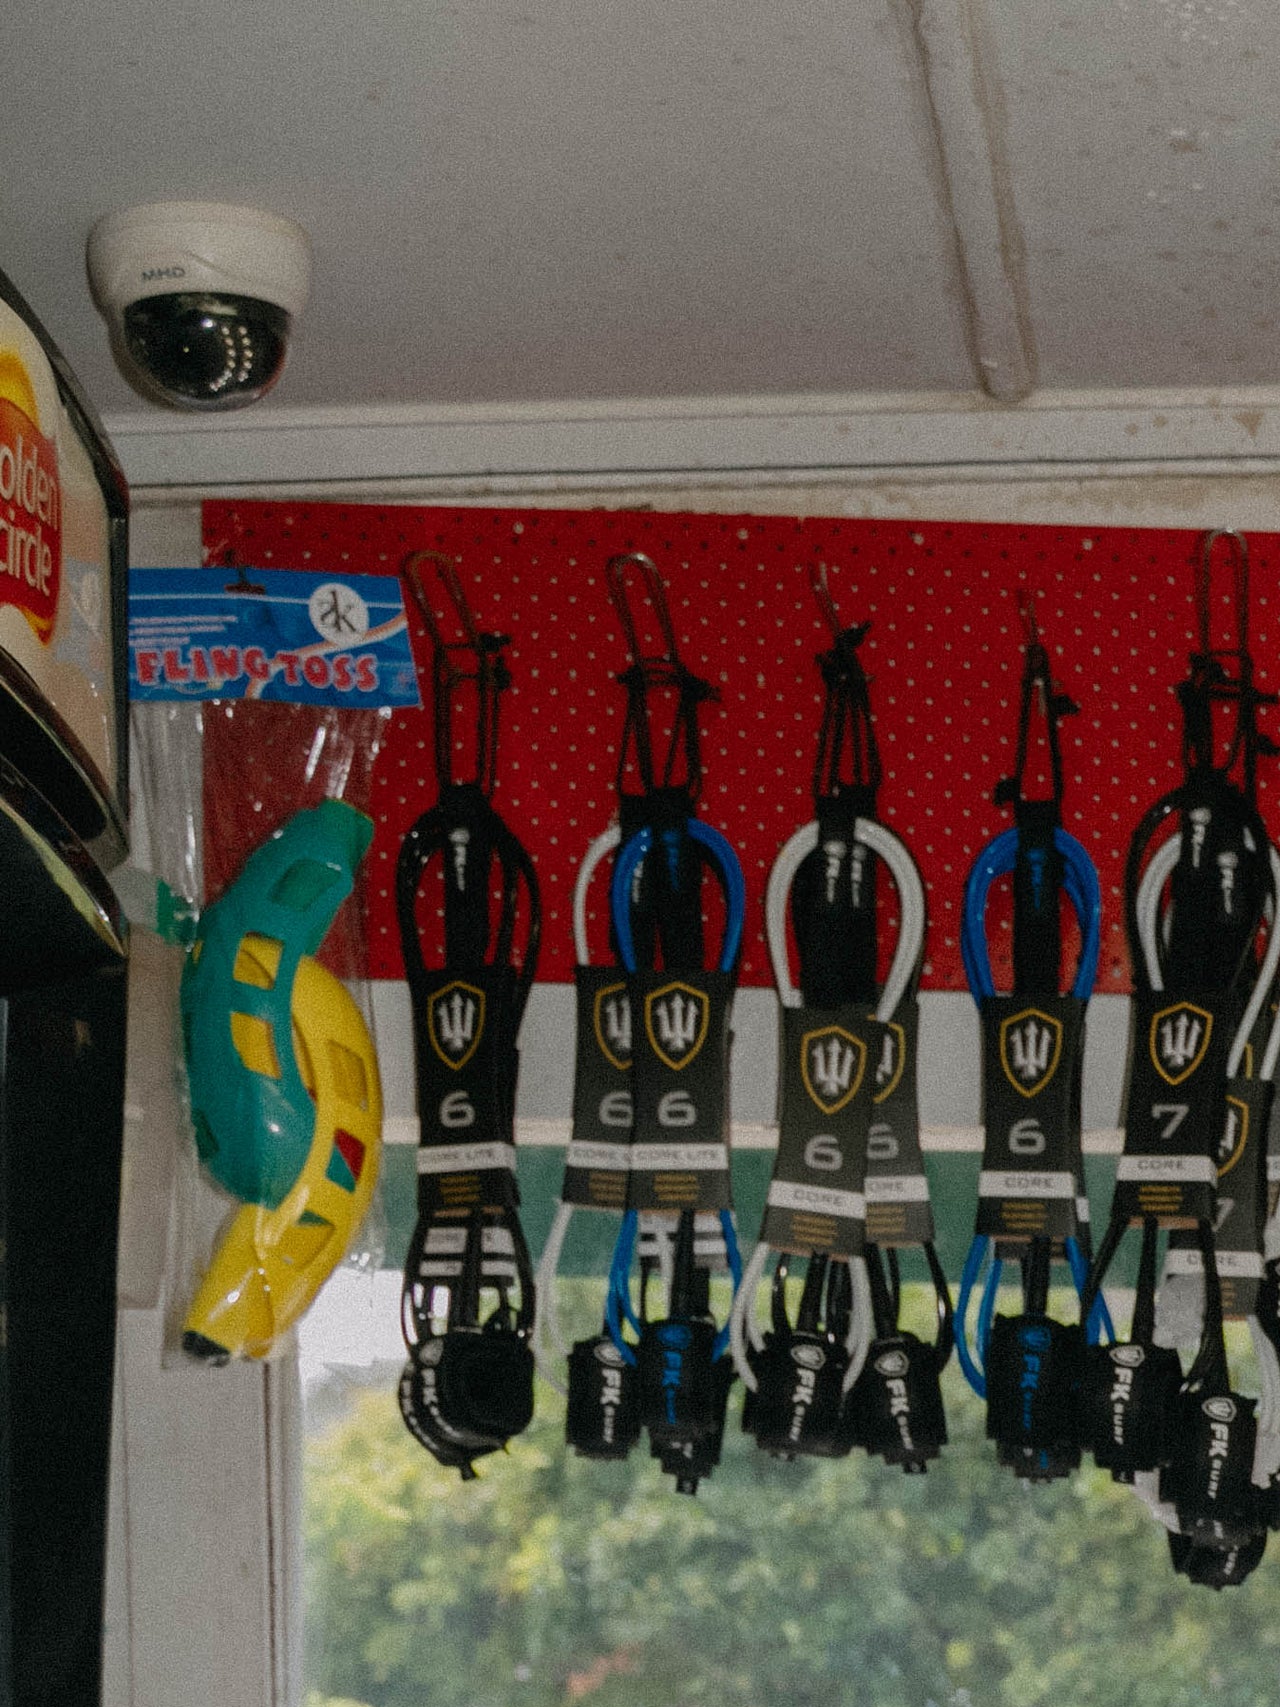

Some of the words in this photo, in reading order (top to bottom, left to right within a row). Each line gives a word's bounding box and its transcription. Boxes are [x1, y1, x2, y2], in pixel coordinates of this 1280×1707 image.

[142, 267, 187, 282] MHD
[0, 434, 60, 530] olden
[136, 648, 268, 688] FLING
[270, 654, 380, 693] TOSS
[440, 1091, 476, 1128] 6
[600, 1091, 633, 1128] 6
[657, 1090, 697, 1128] 6
[1151, 1103, 1190, 1140] 7
[804, 1133, 843, 1172] 6
[1008, 1118, 1046, 1156] 6
[1003, 1176, 1055, 1191] CORE
[1136, 1158, 1186, 1174] CORE
[601, 1367, 622, 1406] FK
[793, 1367, 817, 1406] FK
[886, 1377, 911, 1417] FK
[1110, 1366, 1133, 1402] FK
[1208, 1421, 1230, 1458] FK
